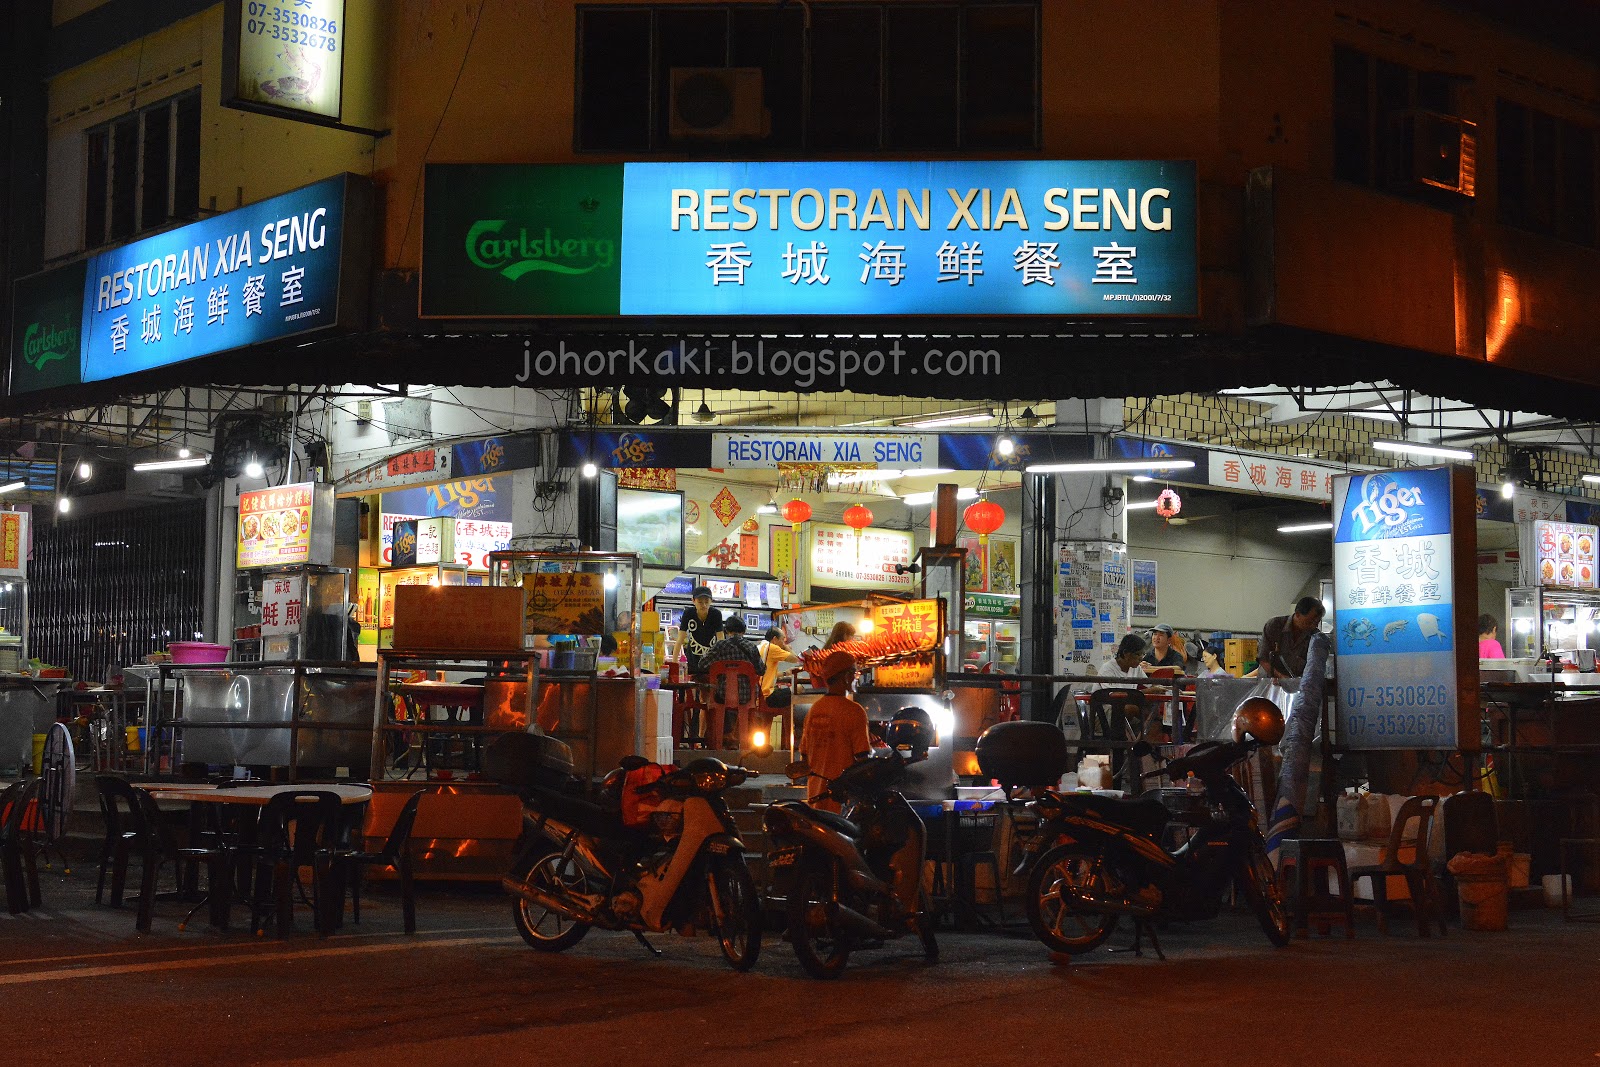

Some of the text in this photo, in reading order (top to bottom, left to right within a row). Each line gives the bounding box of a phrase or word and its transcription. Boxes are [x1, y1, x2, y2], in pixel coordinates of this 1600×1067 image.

[248, 1, 337, 34] 07-3530826
[247, 18, 336, 52] 07-3532678
[671, 188, 1173, 231] RESTORAN XIA SENG
[97, 207, 327, 312] RESTORAN XIA SENG
[465, 219, 615, 270] Carlsberg
[705, 240, 1138, 286] 香城海鲜餐室
[110, 265, 306, 354] 香城海鲜餐室
[23, 322, 77, 364] Carlsberg
[440, 455, 447, 468] 2
[481, 444, 505, 470] Tiger
[612, 438, 655, 464] Tiger
[727, 440, 923, 463] RESTORAN XIA SENG
[426, 477, 496, 511] Tiger
[1351, 481, 1426, 534] Tiger
[394, 531, 416, 556] Tiger
[1348, 539, 1440, 584] 香城
[891, 615, 923, 634] 好味道
[1347, 684, 1447, 708] 07-3530826
[1349, 715, 1447, 736] 07-3532678
